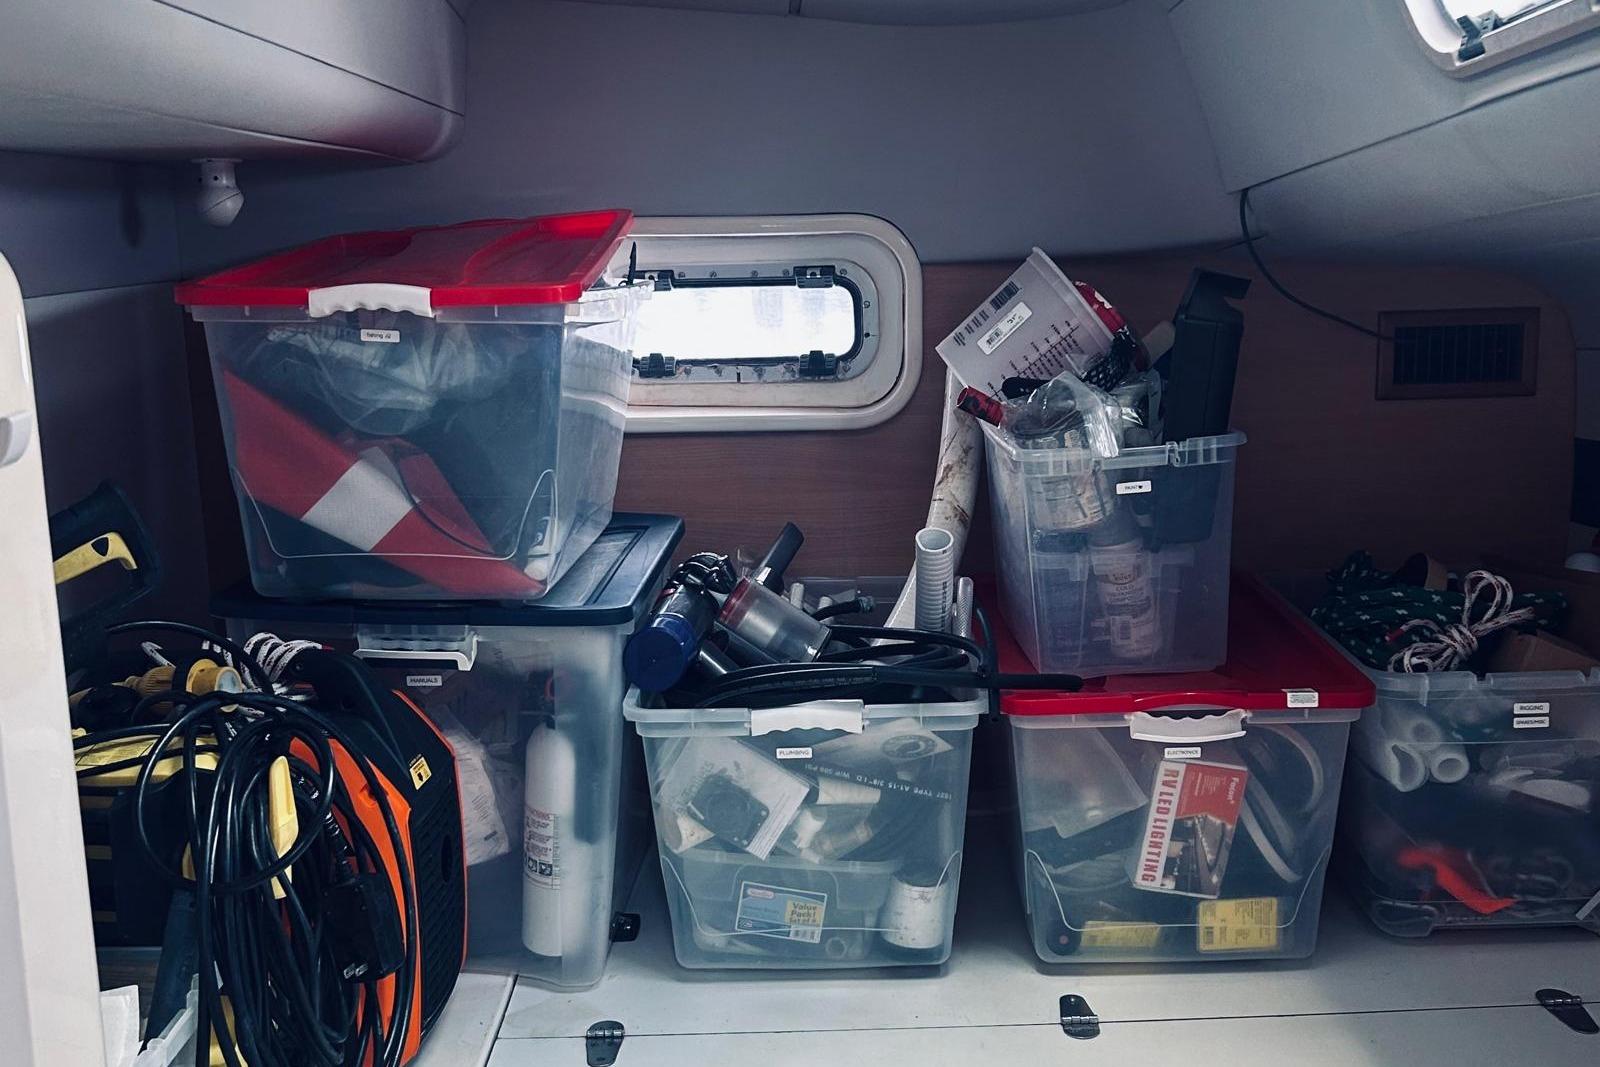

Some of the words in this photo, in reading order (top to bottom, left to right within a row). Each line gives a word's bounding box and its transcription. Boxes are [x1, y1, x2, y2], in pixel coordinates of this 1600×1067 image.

[1161, 768, 1180, 789] RV
[913, 786, 932, 797] TYPE
[1155, 791, 1174, 815] LED
[1141, 817, 1169, 883] LIGHTING
[792, 901, 818, 911] Value
